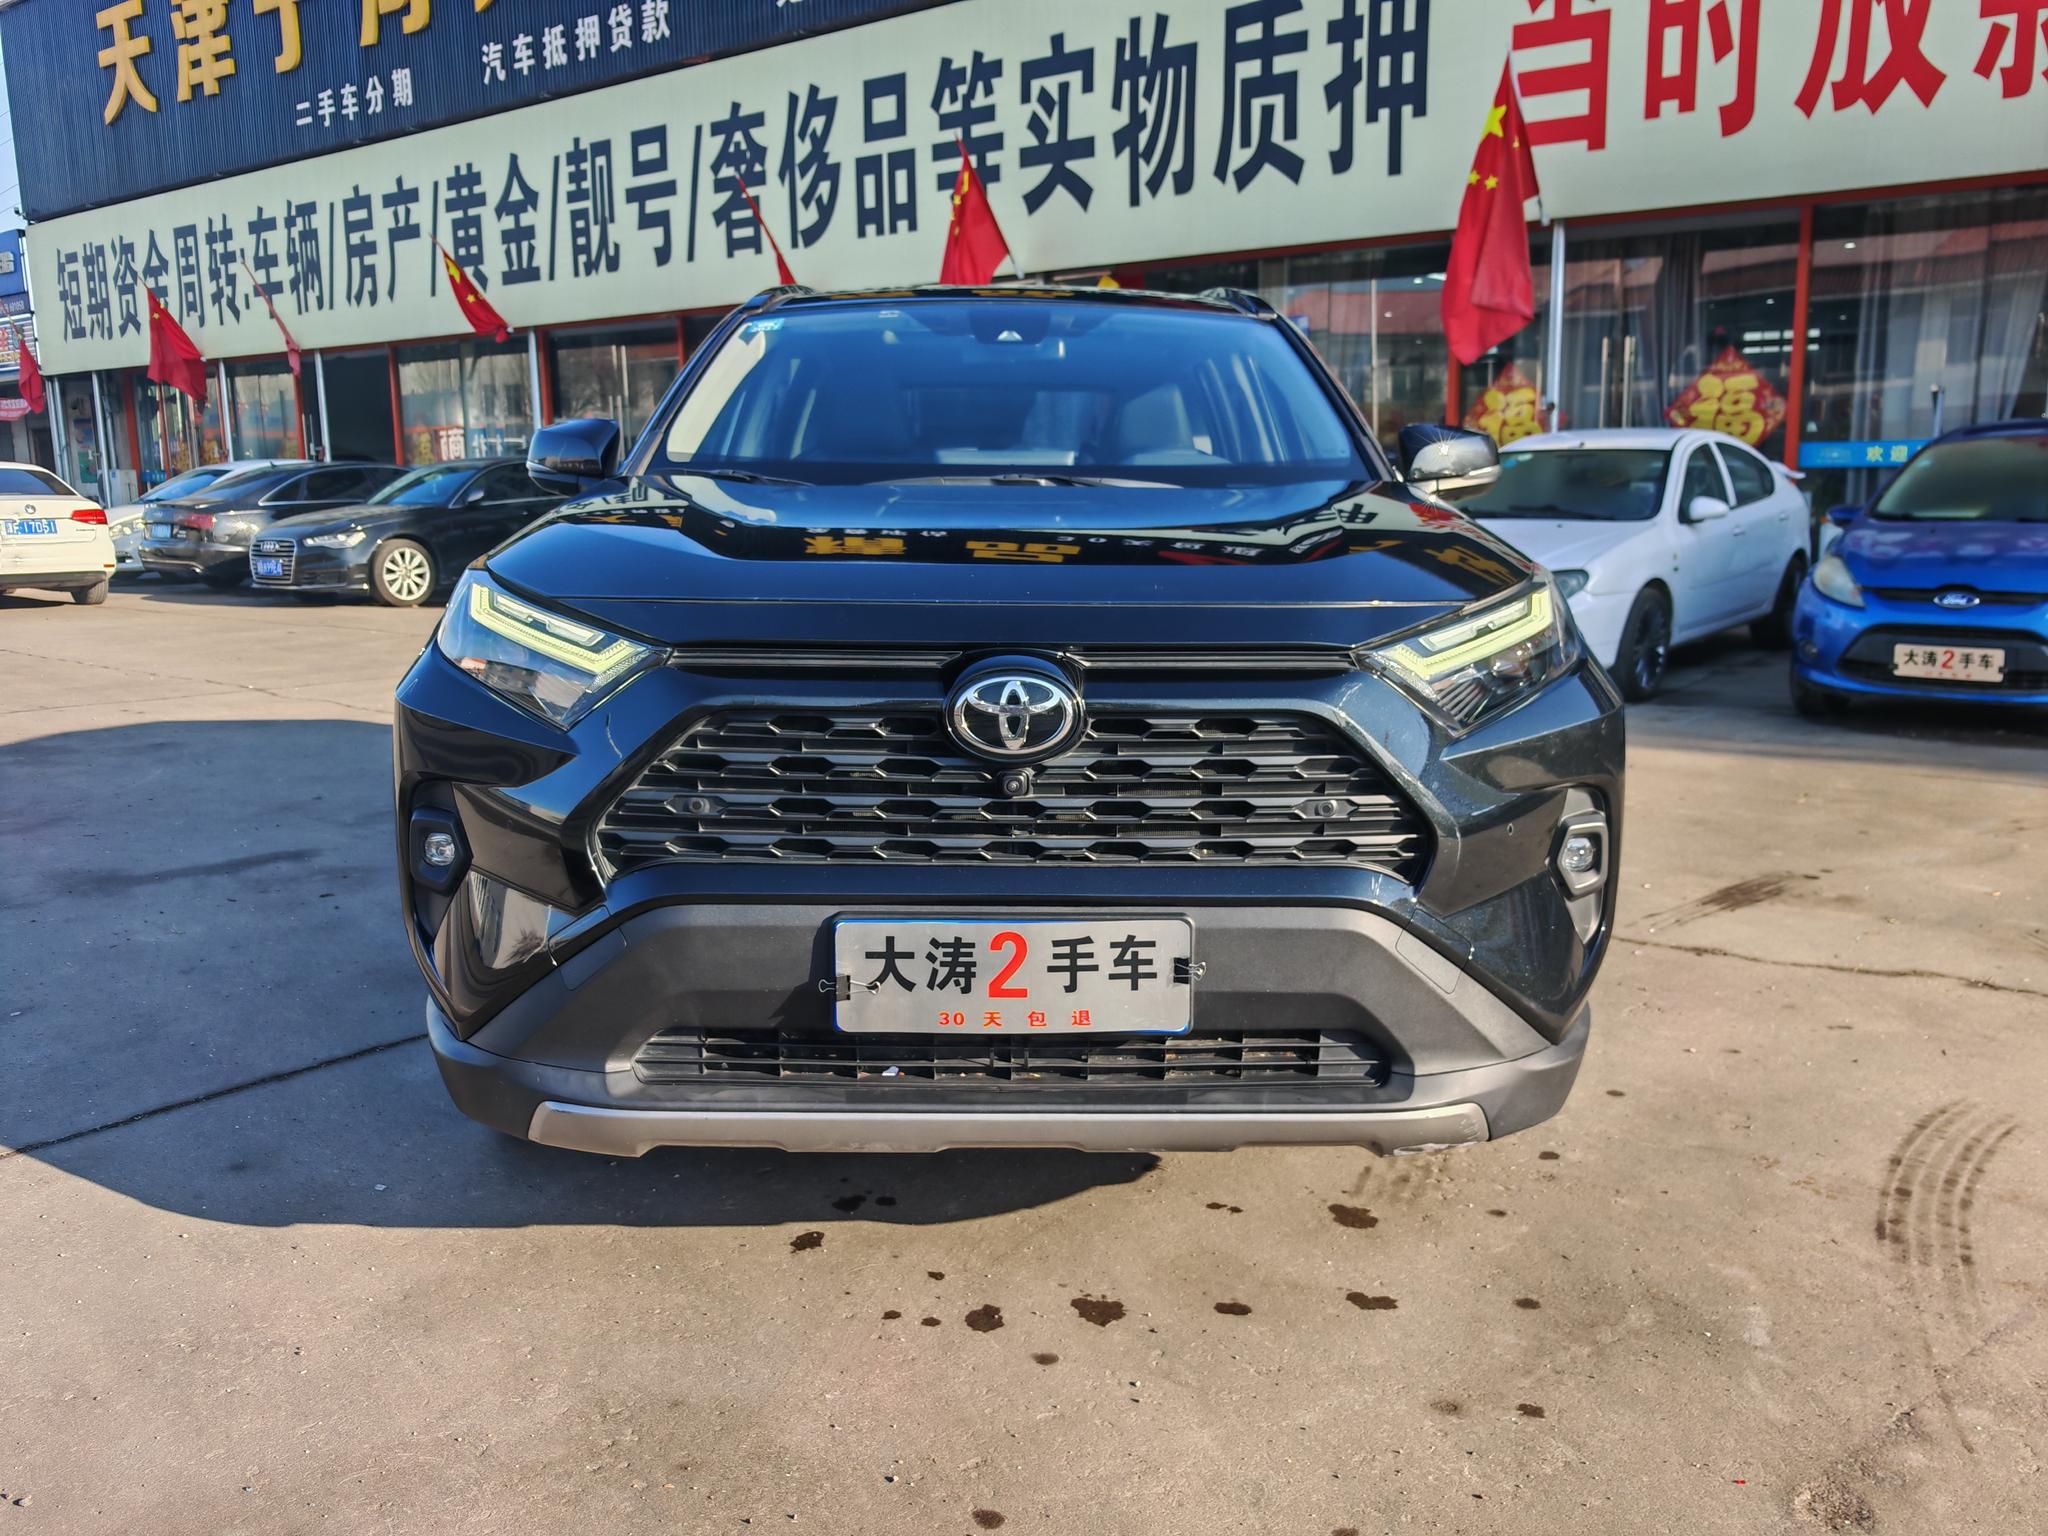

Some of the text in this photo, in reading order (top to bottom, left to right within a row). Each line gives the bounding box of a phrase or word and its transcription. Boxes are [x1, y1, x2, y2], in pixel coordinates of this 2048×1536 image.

[481, 0, 671, 85] 汽车抵押贷款
[295, 68, 414, 127] 二手车分期
[1866, 445, 1910, 463] 欢迎
[1903, 649, 1995, 670] 大涛2手车
[864, 930, 1158, 1000] 大涛2手车
[938, 1009, 1092, 1028] 30天包退
